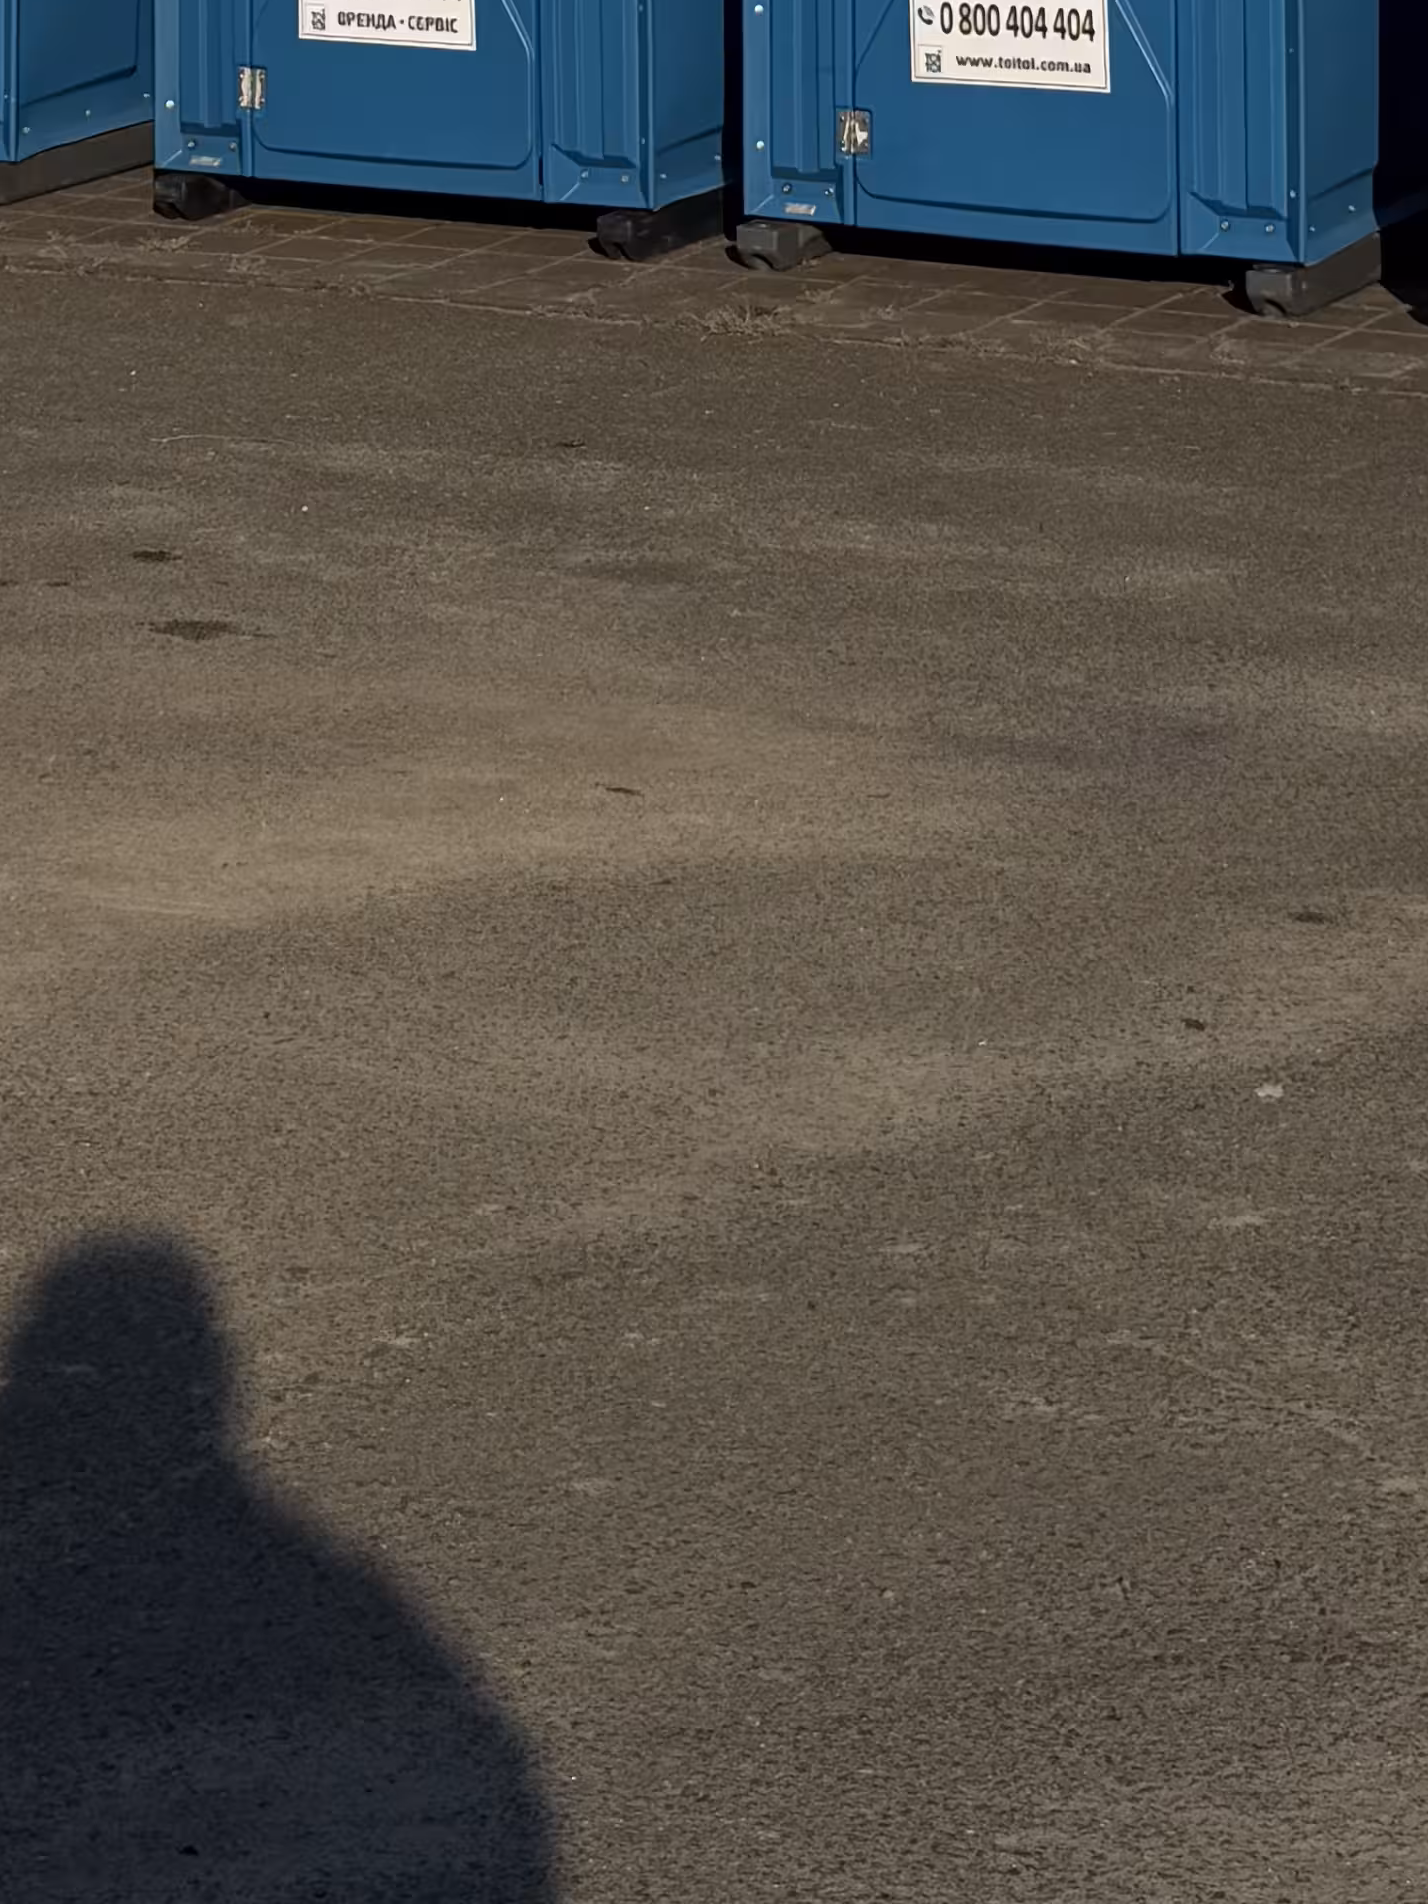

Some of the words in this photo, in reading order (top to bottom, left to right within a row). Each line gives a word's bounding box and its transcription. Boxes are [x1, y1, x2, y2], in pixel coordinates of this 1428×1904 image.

[337, 11, 396, 31] ОРЕНДА
[408, 15, 459, 33] СЕРВІС
[940, 1, 953, 34] 0
[959, 2, 1000, 36] 800
[1006, 5, 1048, 39] 404
[1053, 7, 1095, 42] 404
